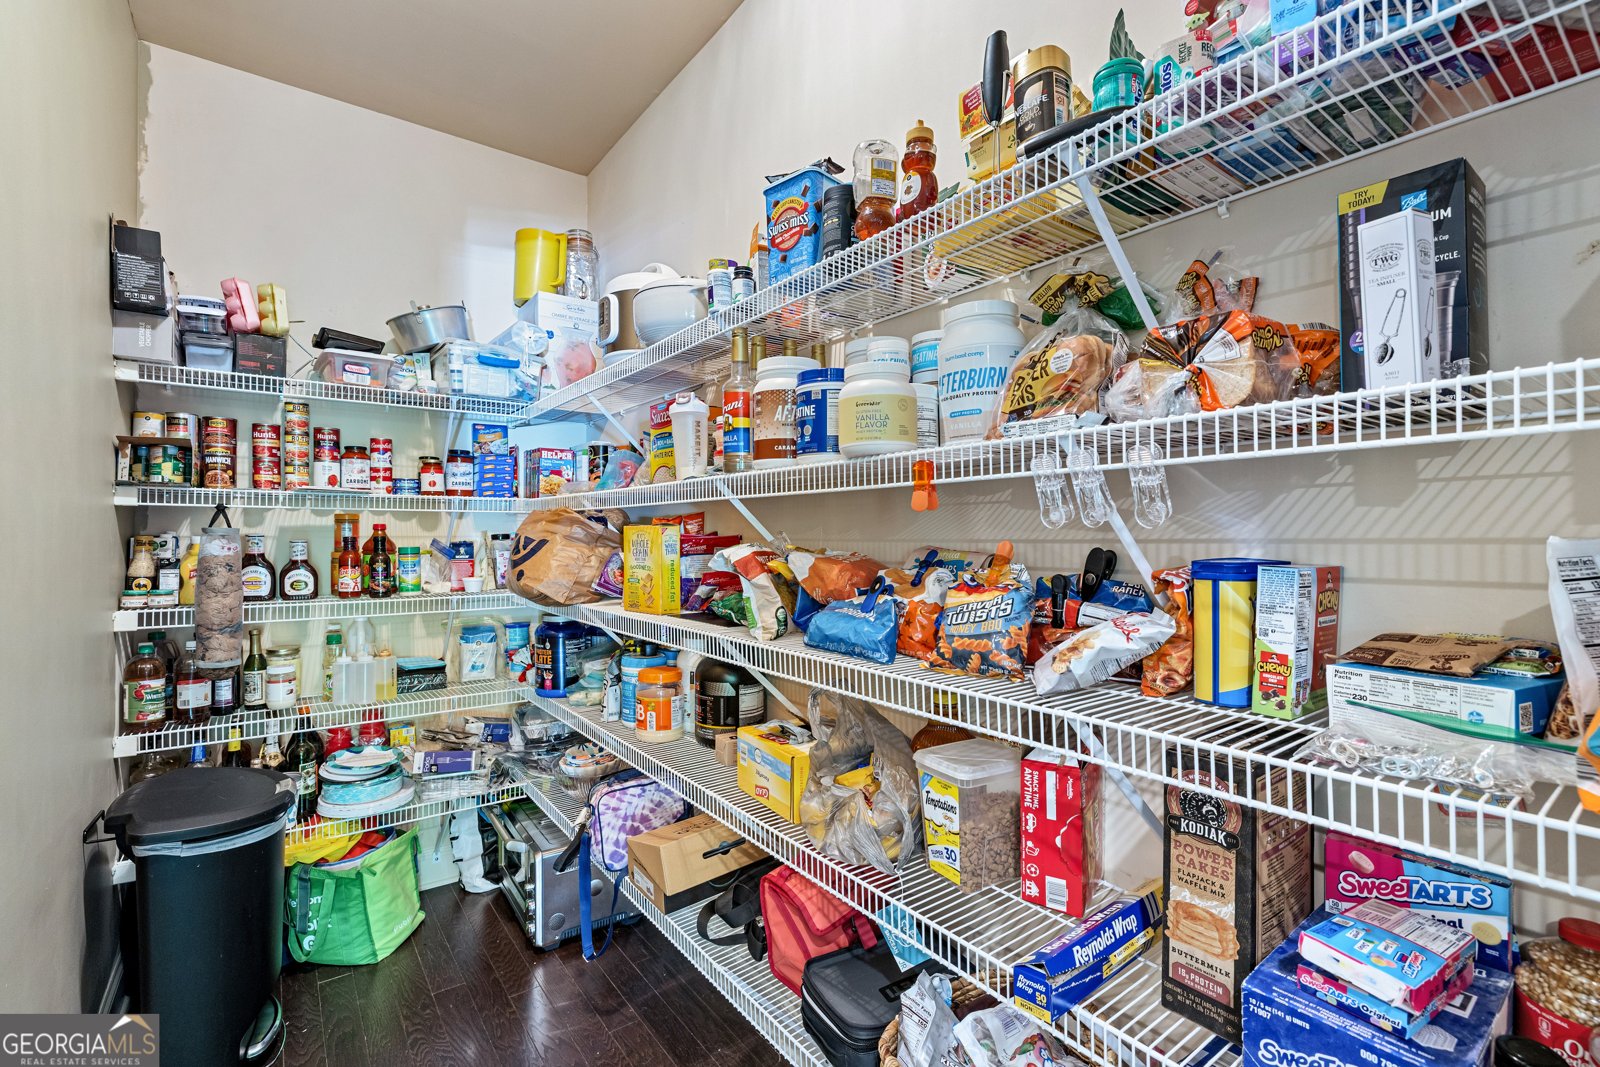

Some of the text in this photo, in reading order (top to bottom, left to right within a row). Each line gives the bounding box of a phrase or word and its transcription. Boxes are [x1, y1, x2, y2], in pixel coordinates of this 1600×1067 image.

[1347, 196, 1375, 209] TODAY!
[1353, 189, 1369, 200] TRY
[768, 220, 789, 240] SWISS
[1371, 253, 1399, 267] TWG
[1434, 250, 1461, 262] CYCLE.
[1376, 279, 1396, 287] SMALL
[723, 396, 744, 412] rani
[796, 405, 816, 418] ATINE
[856, 421, 888, 429] FLAVOR
[541, 450, 573, 460] HELPER
[1111, 586, 1145, 598] RANCH
[957, 595, 1003, 614] FLAVOR
[1318, 588, 1339, 614] CHEWY
[946, 597, 1014, 626] TWISTS
[950, 619, 1003, 633] HONEY BBQ
[1257, 661, 1292, 677] CHEWY
[1334, 669, 1363, 677] Nutrition
[1352, 693, 1368, 702] 230
[1023, 766, 1033, 808] ANYTIME
[925, 790, 957, 815] Temptations
[1180, 817, 1227, 847] KODIAK
[944, 846, 957, 862] 30
[1172, 839, 1233, 870] POWER
[1175, 853, 1230, 881] CAKES
[1177, 867, 1225, 891] FLAPJACK &
[1177, 875, 1226, 899] WAFFLE MIX
[1338, 870, 1492, 908] SweeTARTS
[1072, 926, 1115, 967] Reynolds
[1111, 914, 1138, 940] Wrap
[1171, 945, 1231, 979] BUTTERMILK
[1016, 980, 1034, 995] Wrap
[1018, 974, 1047, 992] Reynolds
[1190, 971, 1224, 996] PROTEIN
[1035, 991, 1047, 1003] 50
[1300, 973, 1358, 1008] SweeTARTS
[1360, 1002, 1401, 1029] Original
[1292, 1017, 1310, 1030] UNITS
